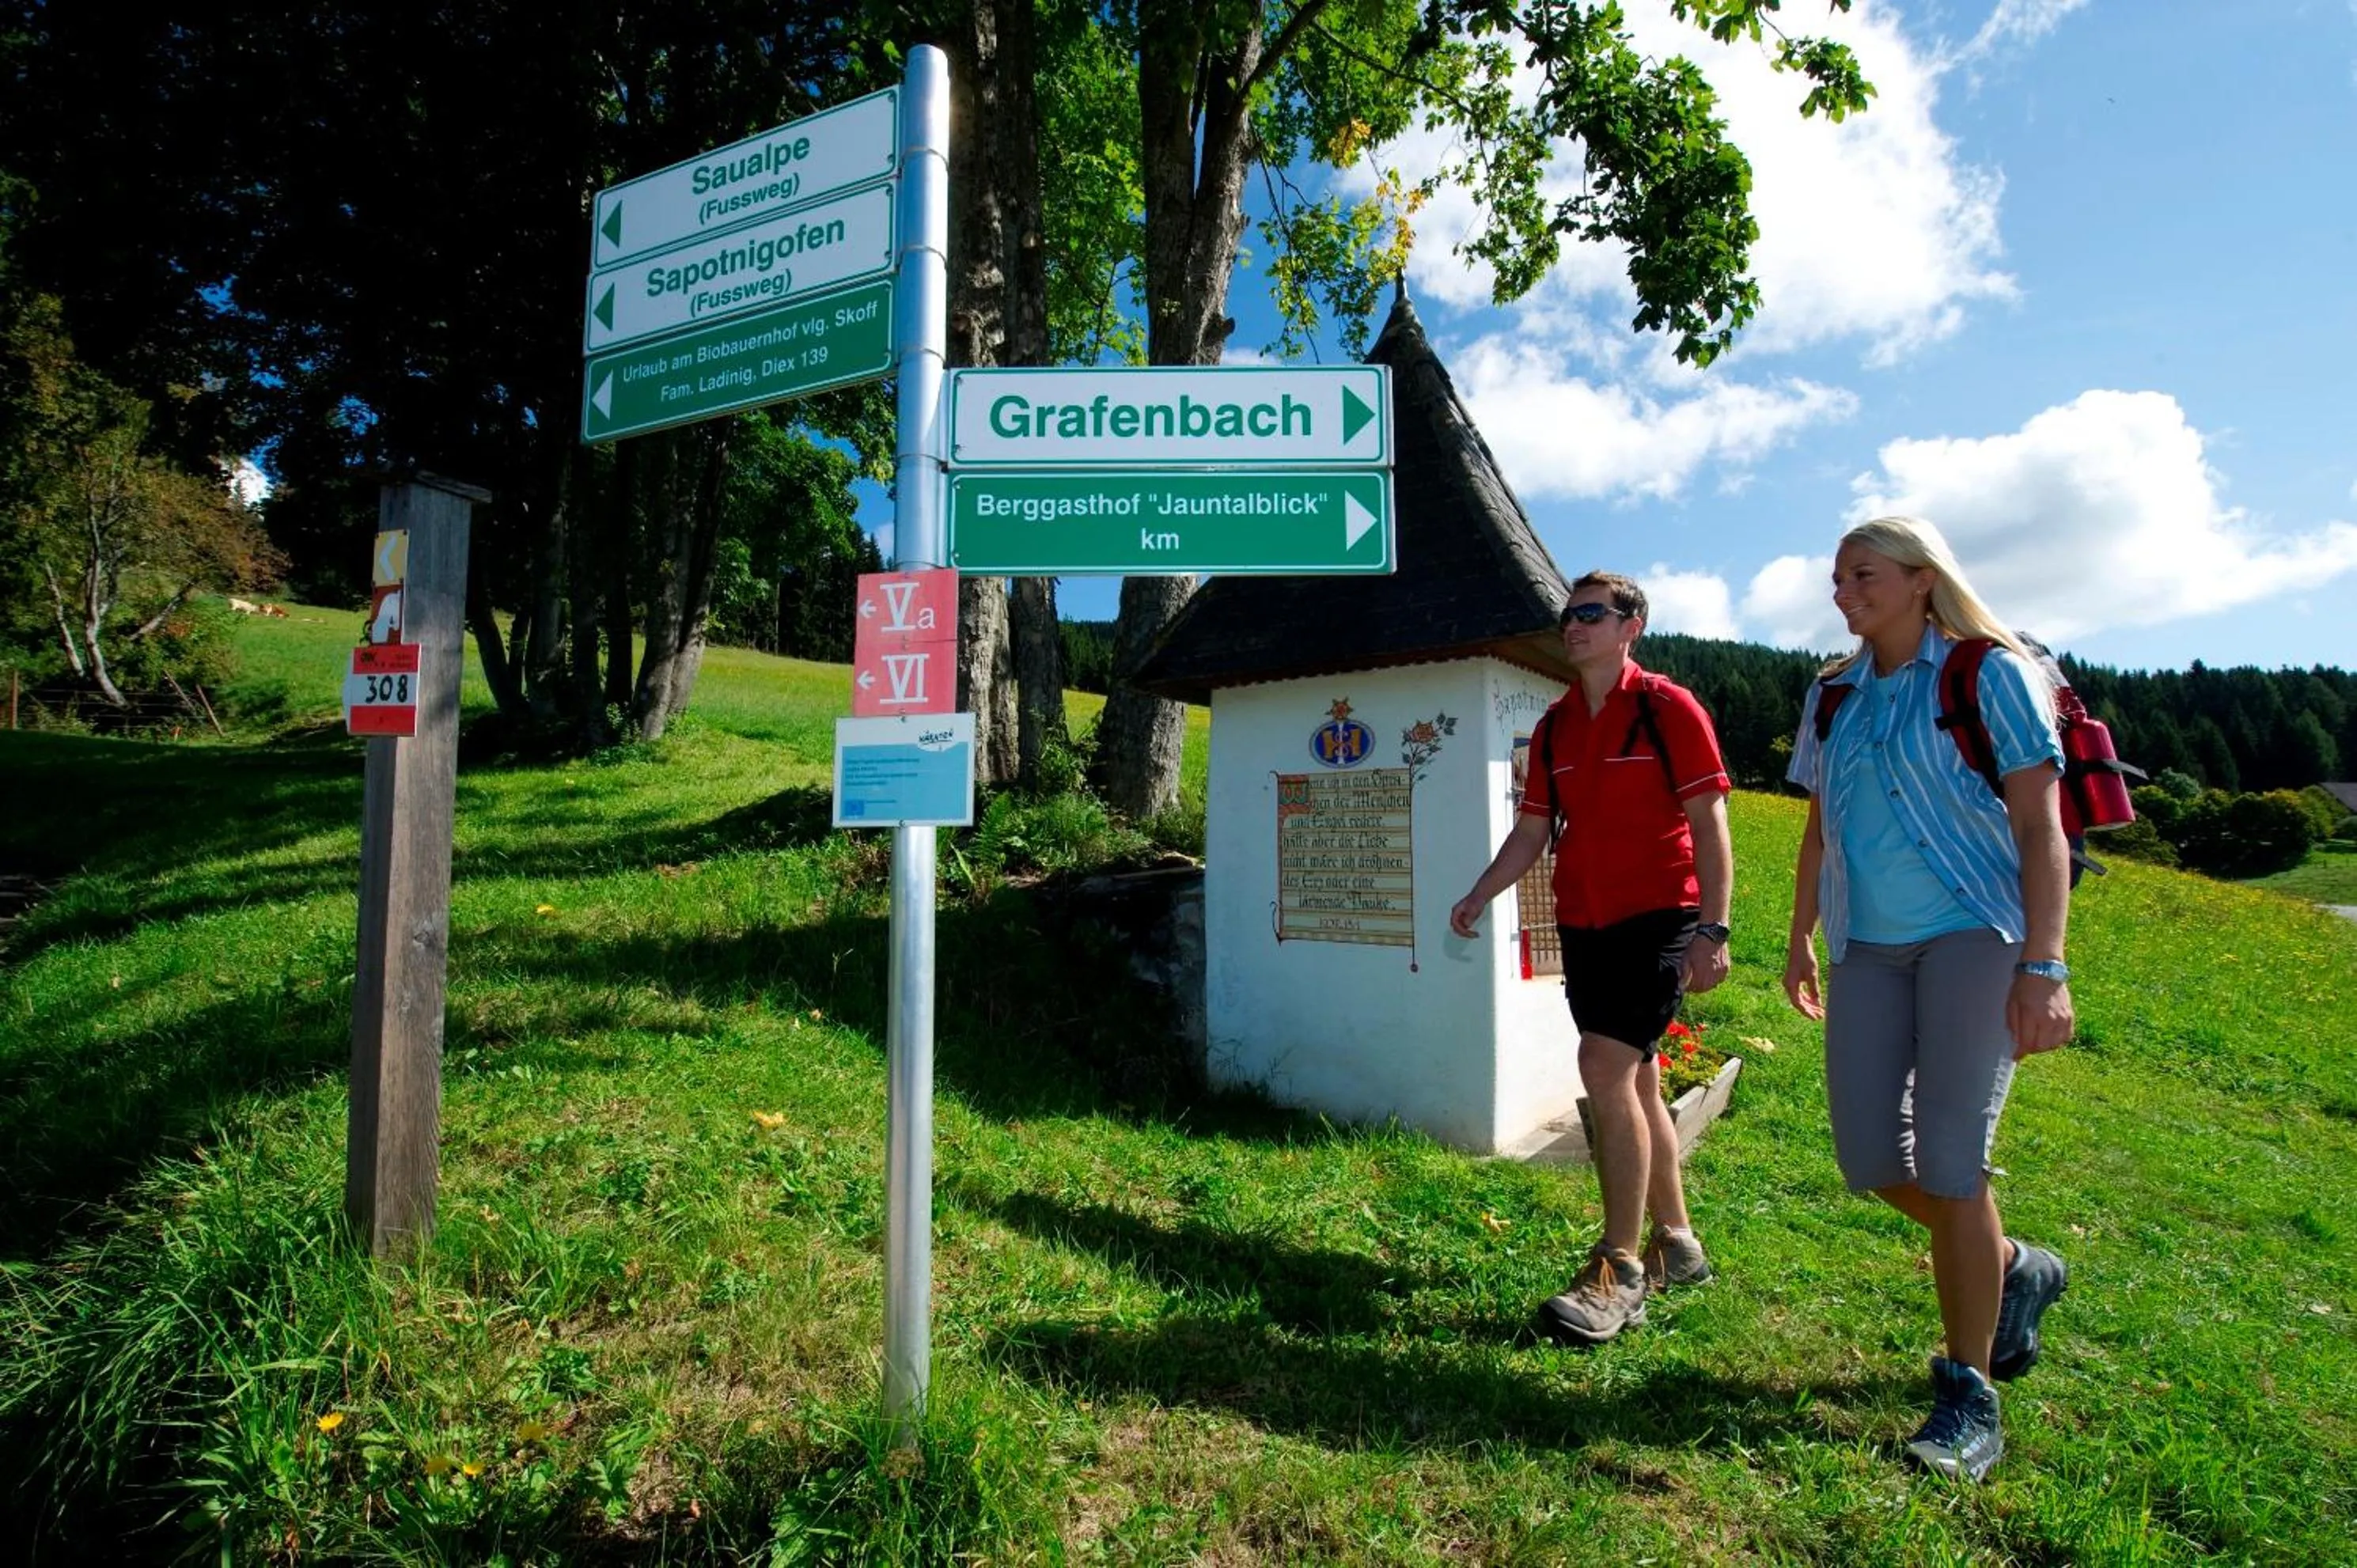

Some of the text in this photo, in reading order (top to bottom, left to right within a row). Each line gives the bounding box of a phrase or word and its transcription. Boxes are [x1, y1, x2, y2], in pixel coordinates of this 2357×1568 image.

[692, 137, 810, 195] Saualpe
[699, 172, 801, 225] (Fussweg)
[646, 218, 844, 297] Sapotnigofen
[690, 270, 792, 319] (Fussweg)
[623, 301, 878, 383] Urlaub am Biobauernhof vlg. Skoff
[660, 347, 828, 403] Fam. Ladinig, Diex 139
[989, 394, 1313, 438] Grafenbach
[976, 493, 1328, 521] Berggasthof "Jauntalblick"
[1141, 529, 1180, 551] km
[366, 674, 408, 703] 308
[880, 653, 930, 705] VI
